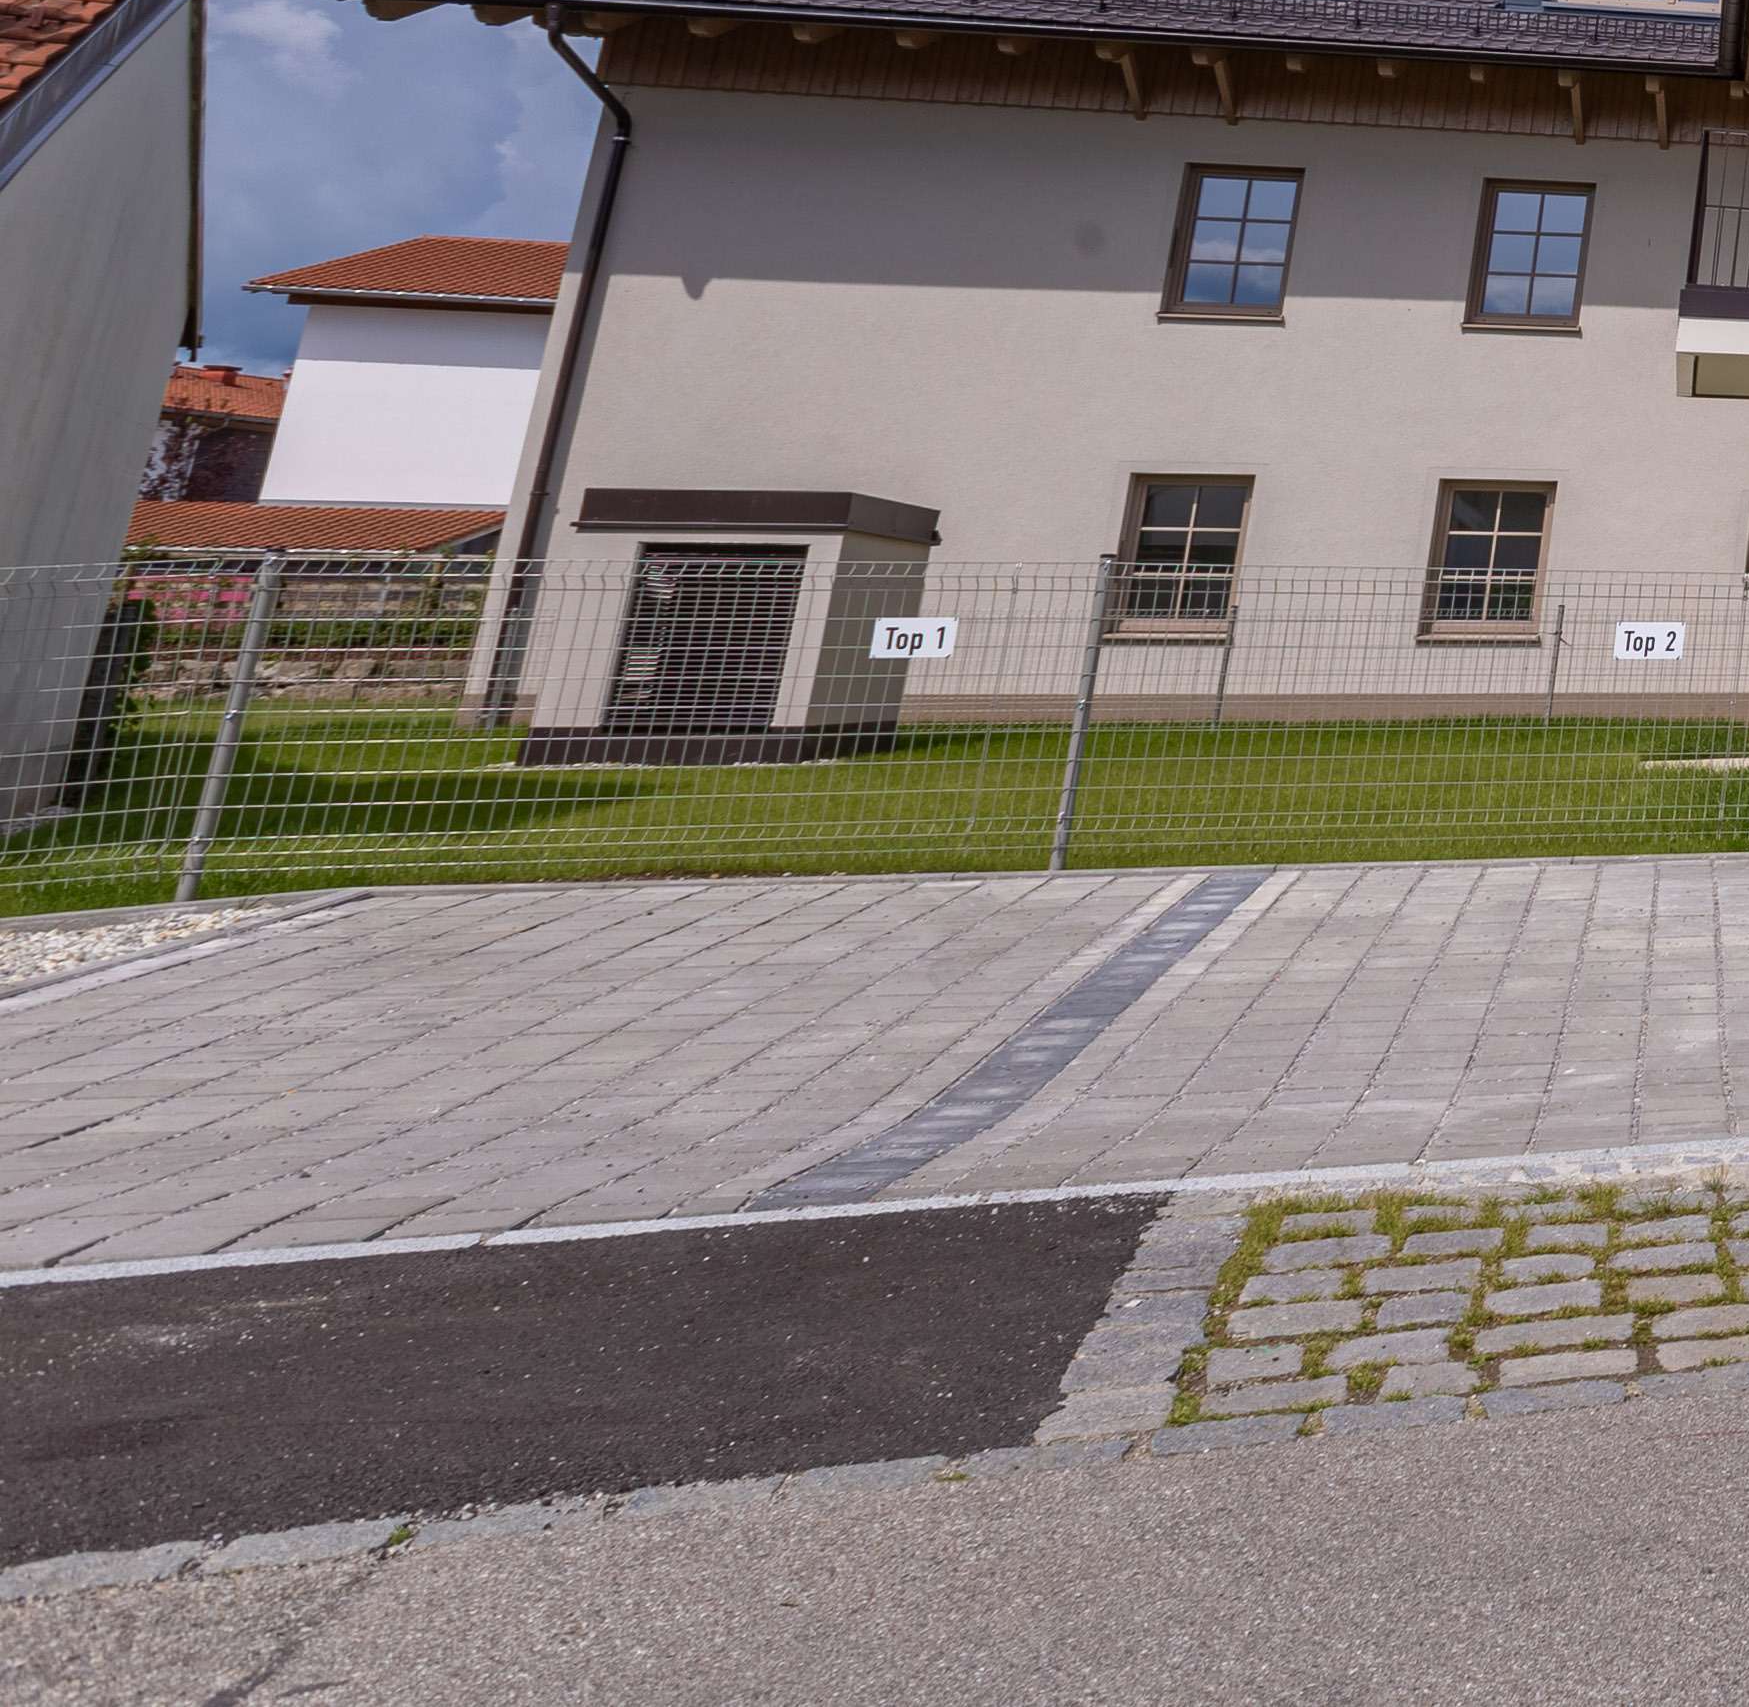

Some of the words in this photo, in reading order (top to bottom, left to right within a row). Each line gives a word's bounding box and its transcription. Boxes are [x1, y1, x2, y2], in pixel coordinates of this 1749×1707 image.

[885, 626, 924, 656] Top
[936, 626, 946, 649] 1
[1624, 630, 1656, 657] Top
[1665, 630, 1677, 651] 2
